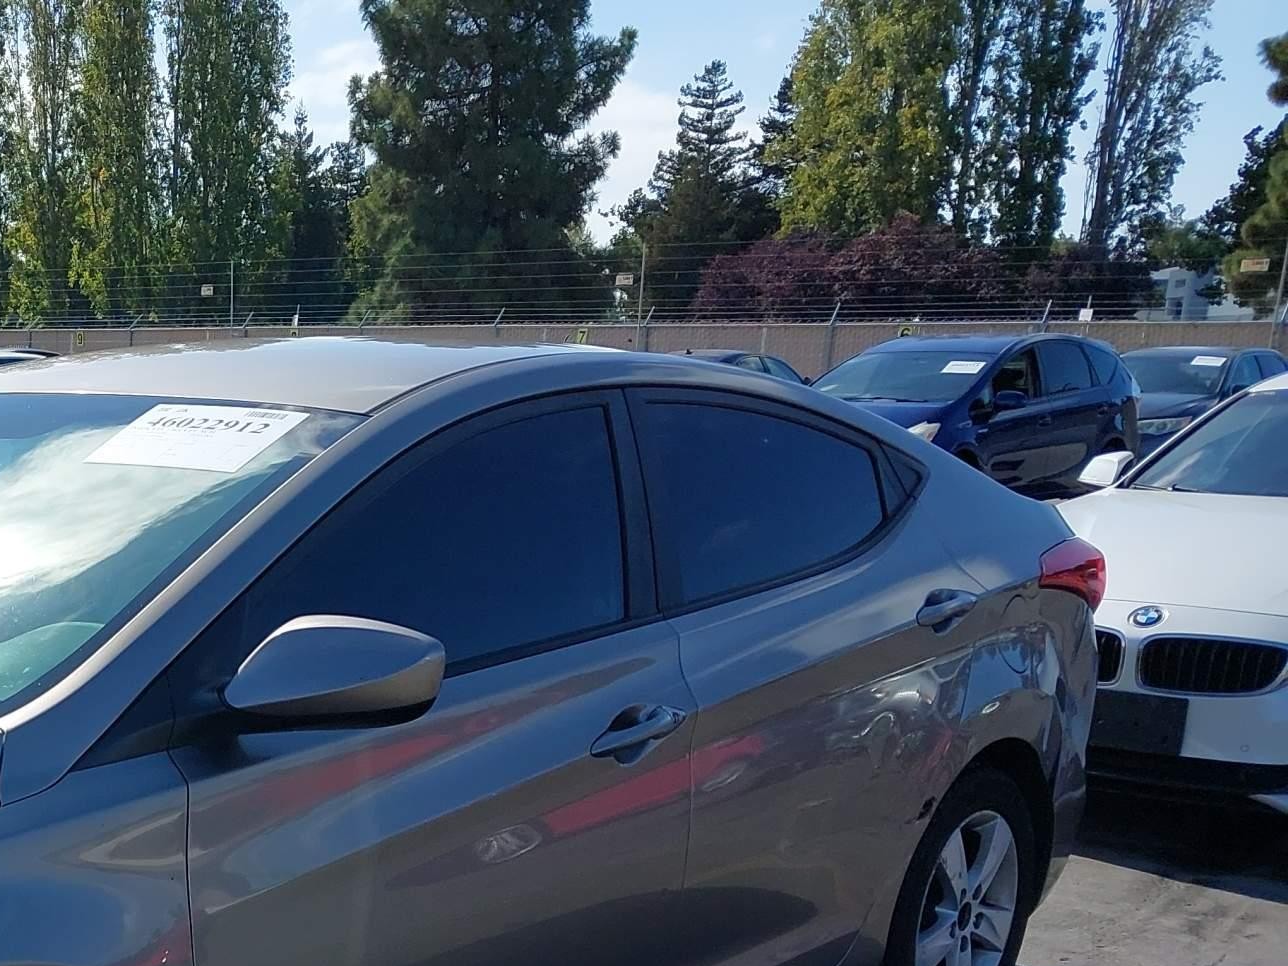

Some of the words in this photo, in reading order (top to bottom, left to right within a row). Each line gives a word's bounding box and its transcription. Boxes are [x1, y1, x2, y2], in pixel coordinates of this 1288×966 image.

[77, 332, 83, 345] 9
[579, 330, 586, 344] 7
[147, 415, 271, 434] 46022912
